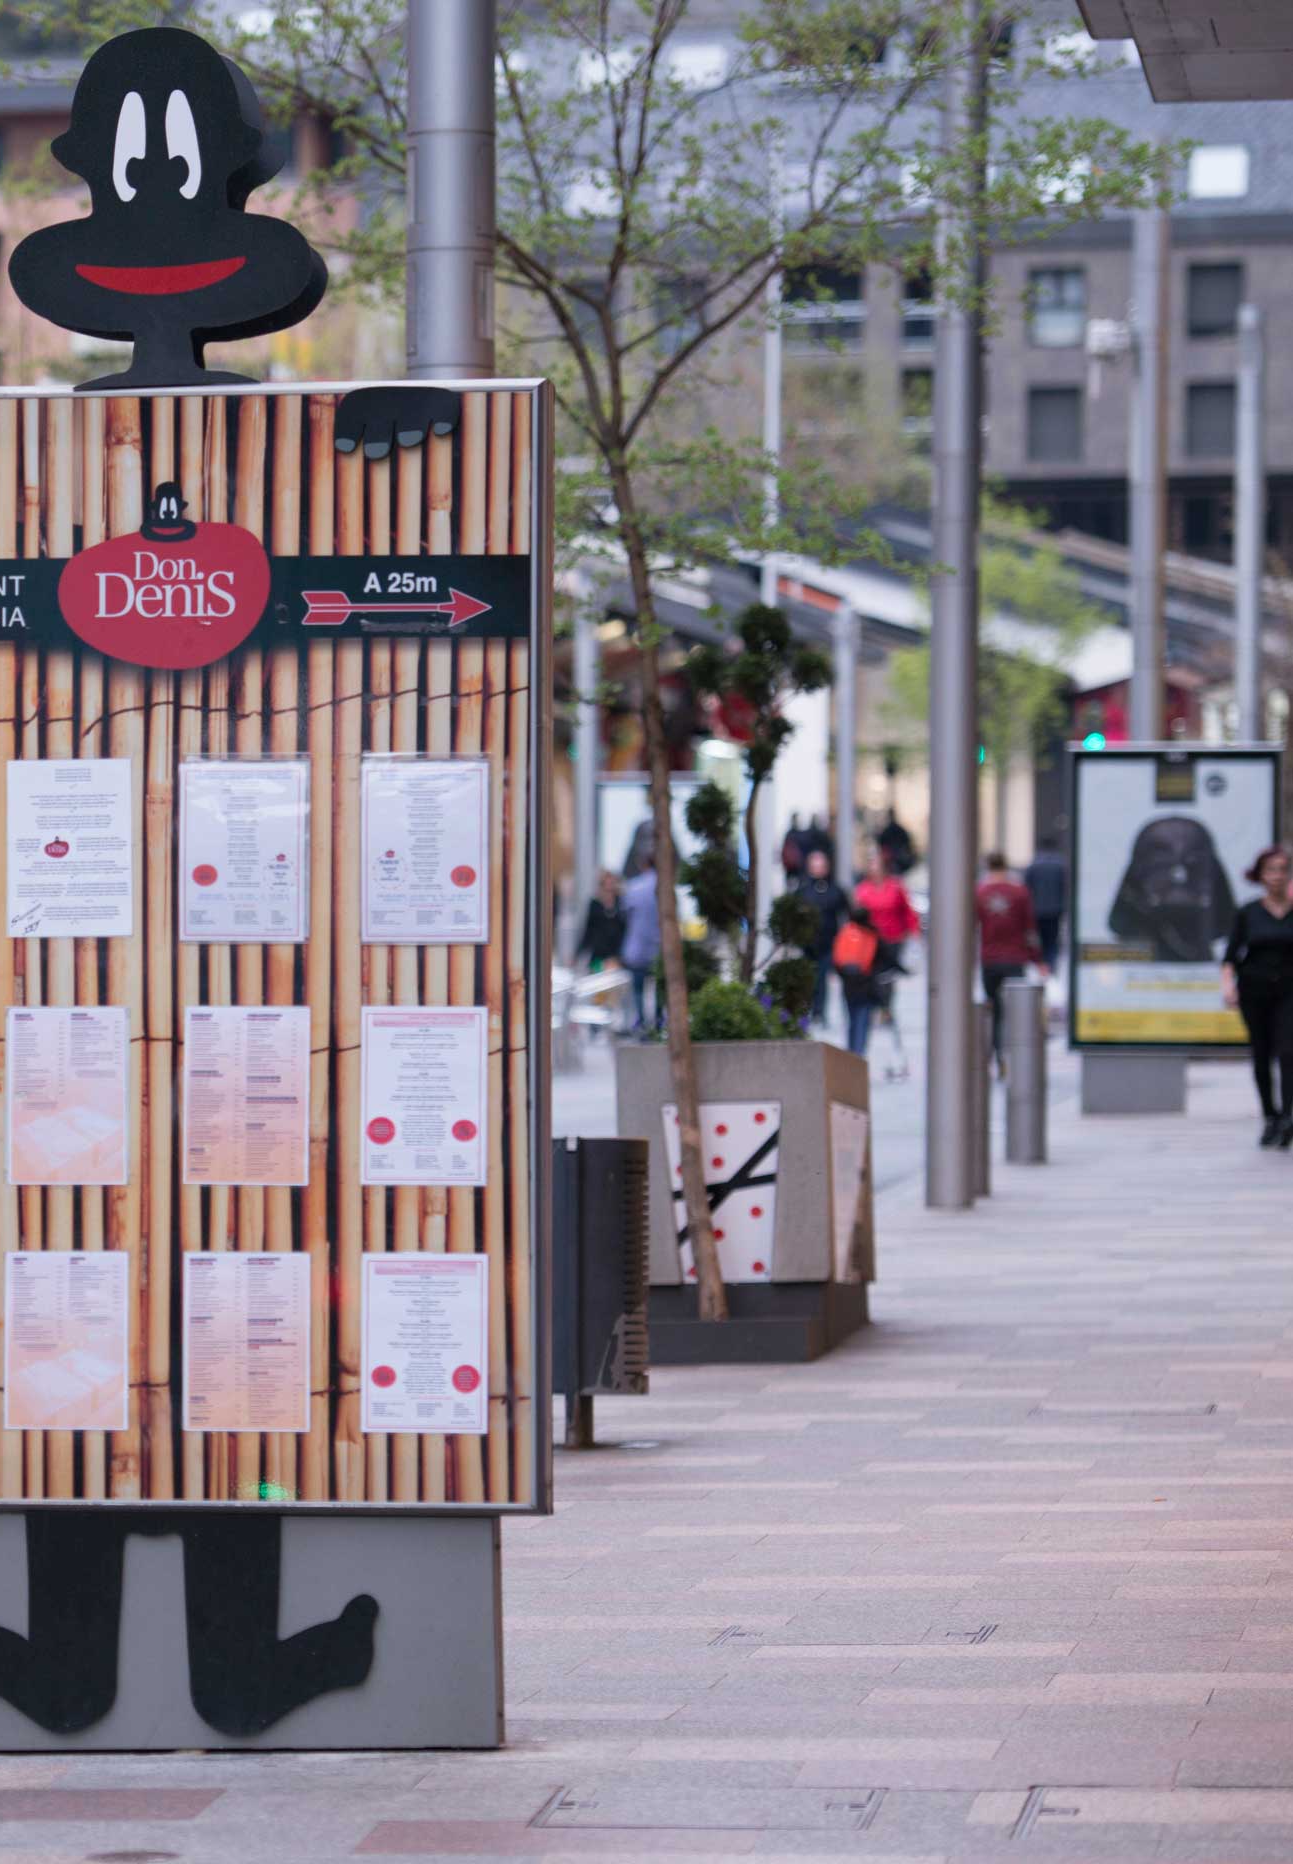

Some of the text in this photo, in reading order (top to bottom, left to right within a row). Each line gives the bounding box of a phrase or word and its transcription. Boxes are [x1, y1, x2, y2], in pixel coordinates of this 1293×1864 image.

[133, 551, 198, 581] Don
[363, 572, 437, 593] A 25m
